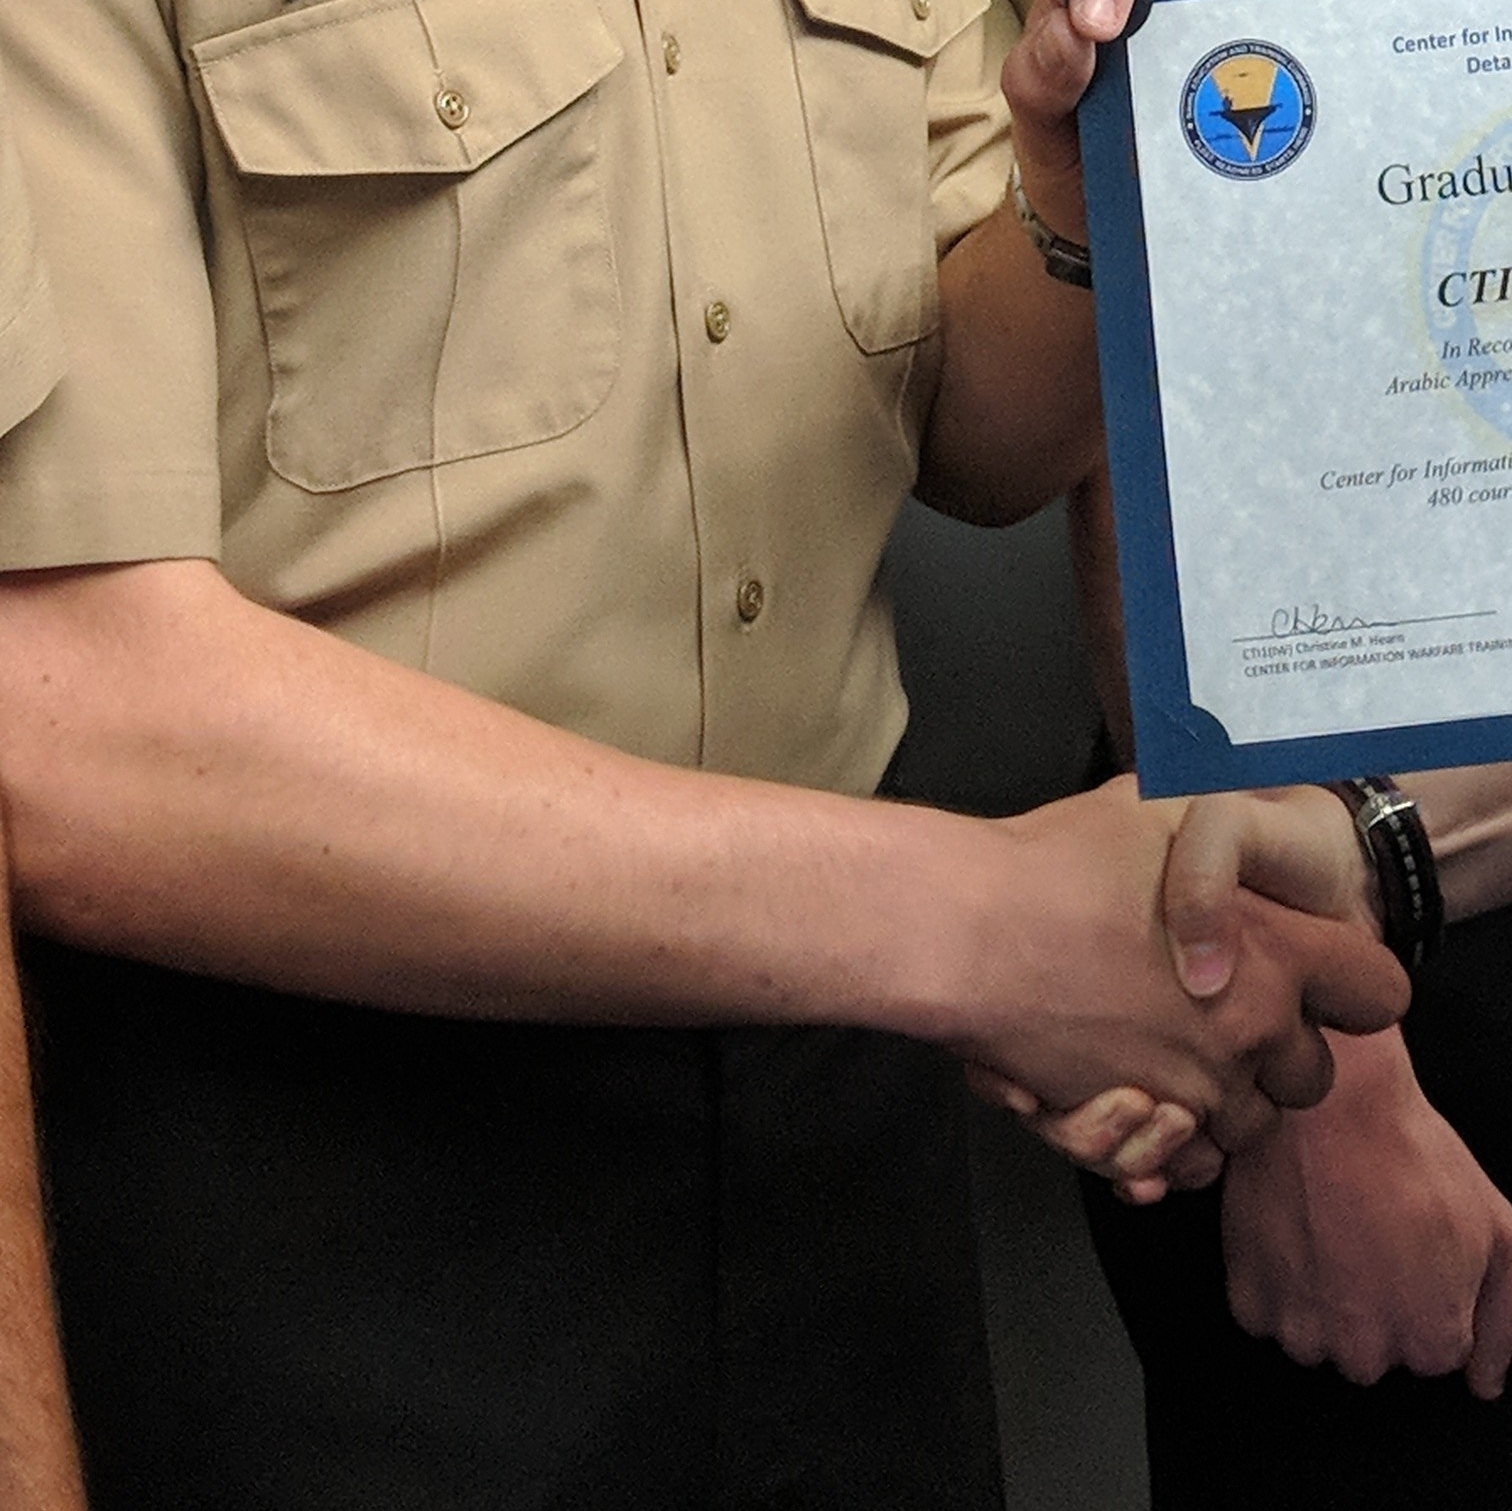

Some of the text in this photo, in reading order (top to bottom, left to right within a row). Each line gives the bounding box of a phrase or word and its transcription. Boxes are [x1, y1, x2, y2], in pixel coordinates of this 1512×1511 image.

[1392, 33, 1457, 55] Center
[1462, 27, 1490, 47] for
[1441, 340, 1462, 360] In
[1385, 371, 1451, 396] Arabic
[1320, 469, 1384, 490] Center
[1387, 463, 1418, 488] for
[1427, 487, 1464, 508] 480
[1293, 658, 1317, 672] FOR
